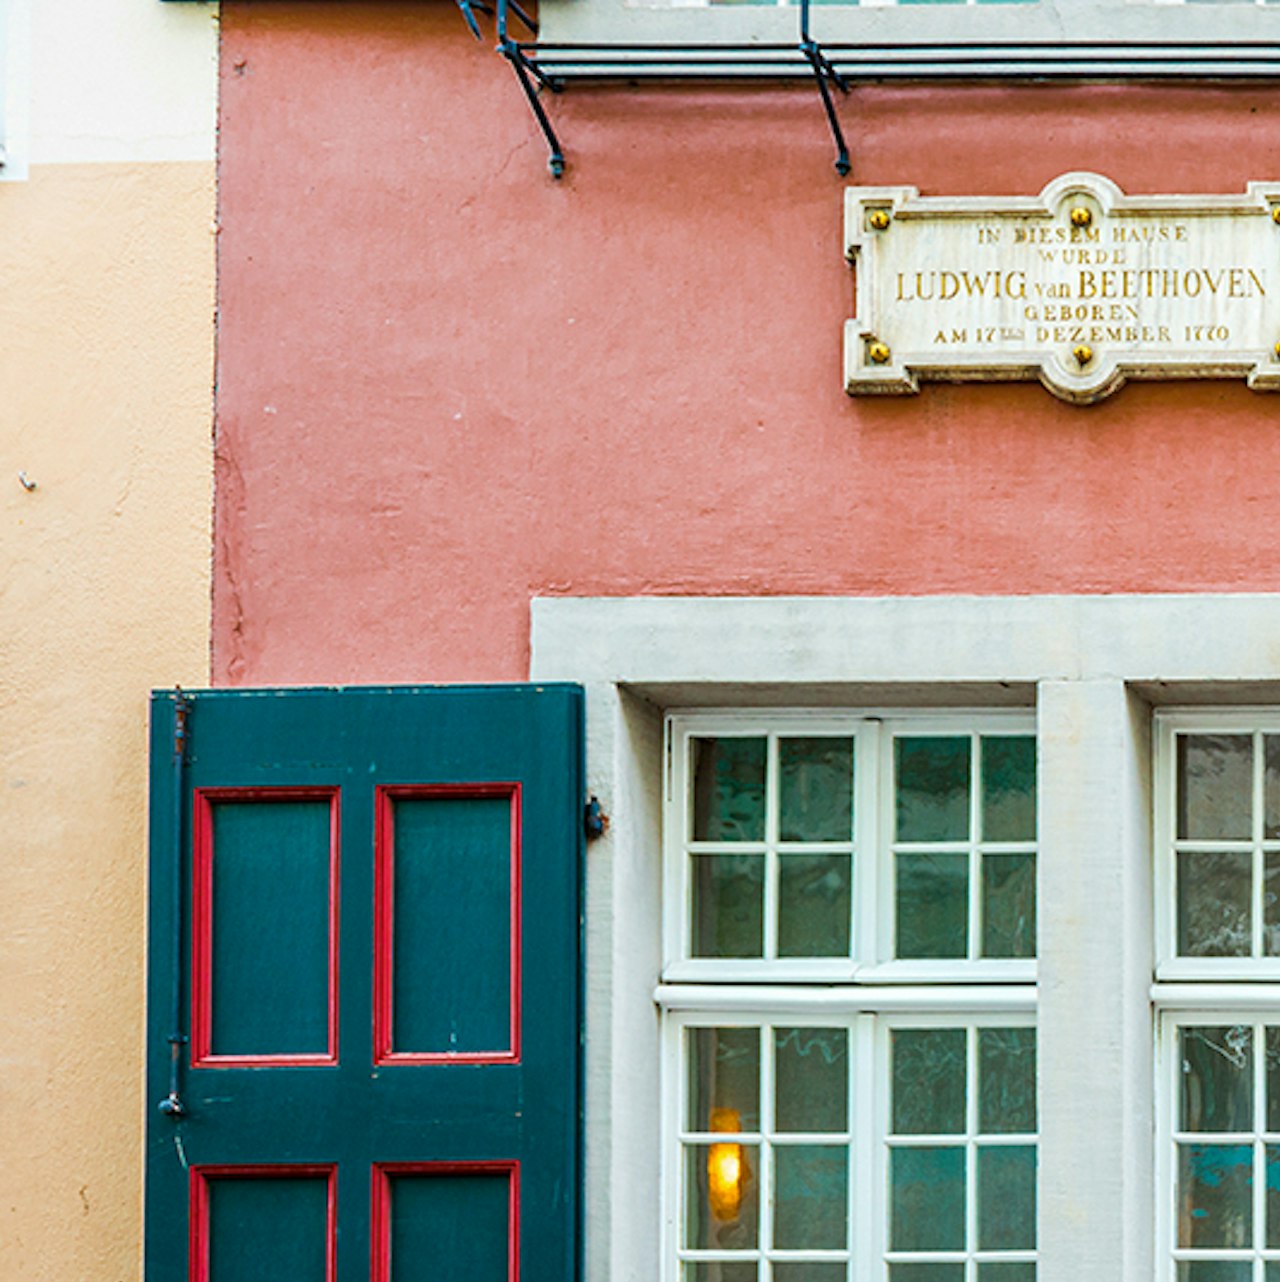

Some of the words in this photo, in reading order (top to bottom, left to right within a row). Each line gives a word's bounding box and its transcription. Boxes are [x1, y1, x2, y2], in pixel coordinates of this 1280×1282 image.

[977, 228, 1001, 244] IN
[1014, 227, 1100, 243] DIESEM
[1112, 226, 1188, 243] HAUSE
[1038, 248, 1127, 265] WURDE
[896, 270, 1027, 300] LUDWIG
[1035, 281, 1071, 299] van
[1078, 268, 1266, 299] BEETHOVEN
[1024, 304, 1139, 321] GEBOREN
[934, 327, 967, 344] AM
[1036, 325, 1171, 343] DEZEMBER
[1184, 325, 1230, 342] 1770
